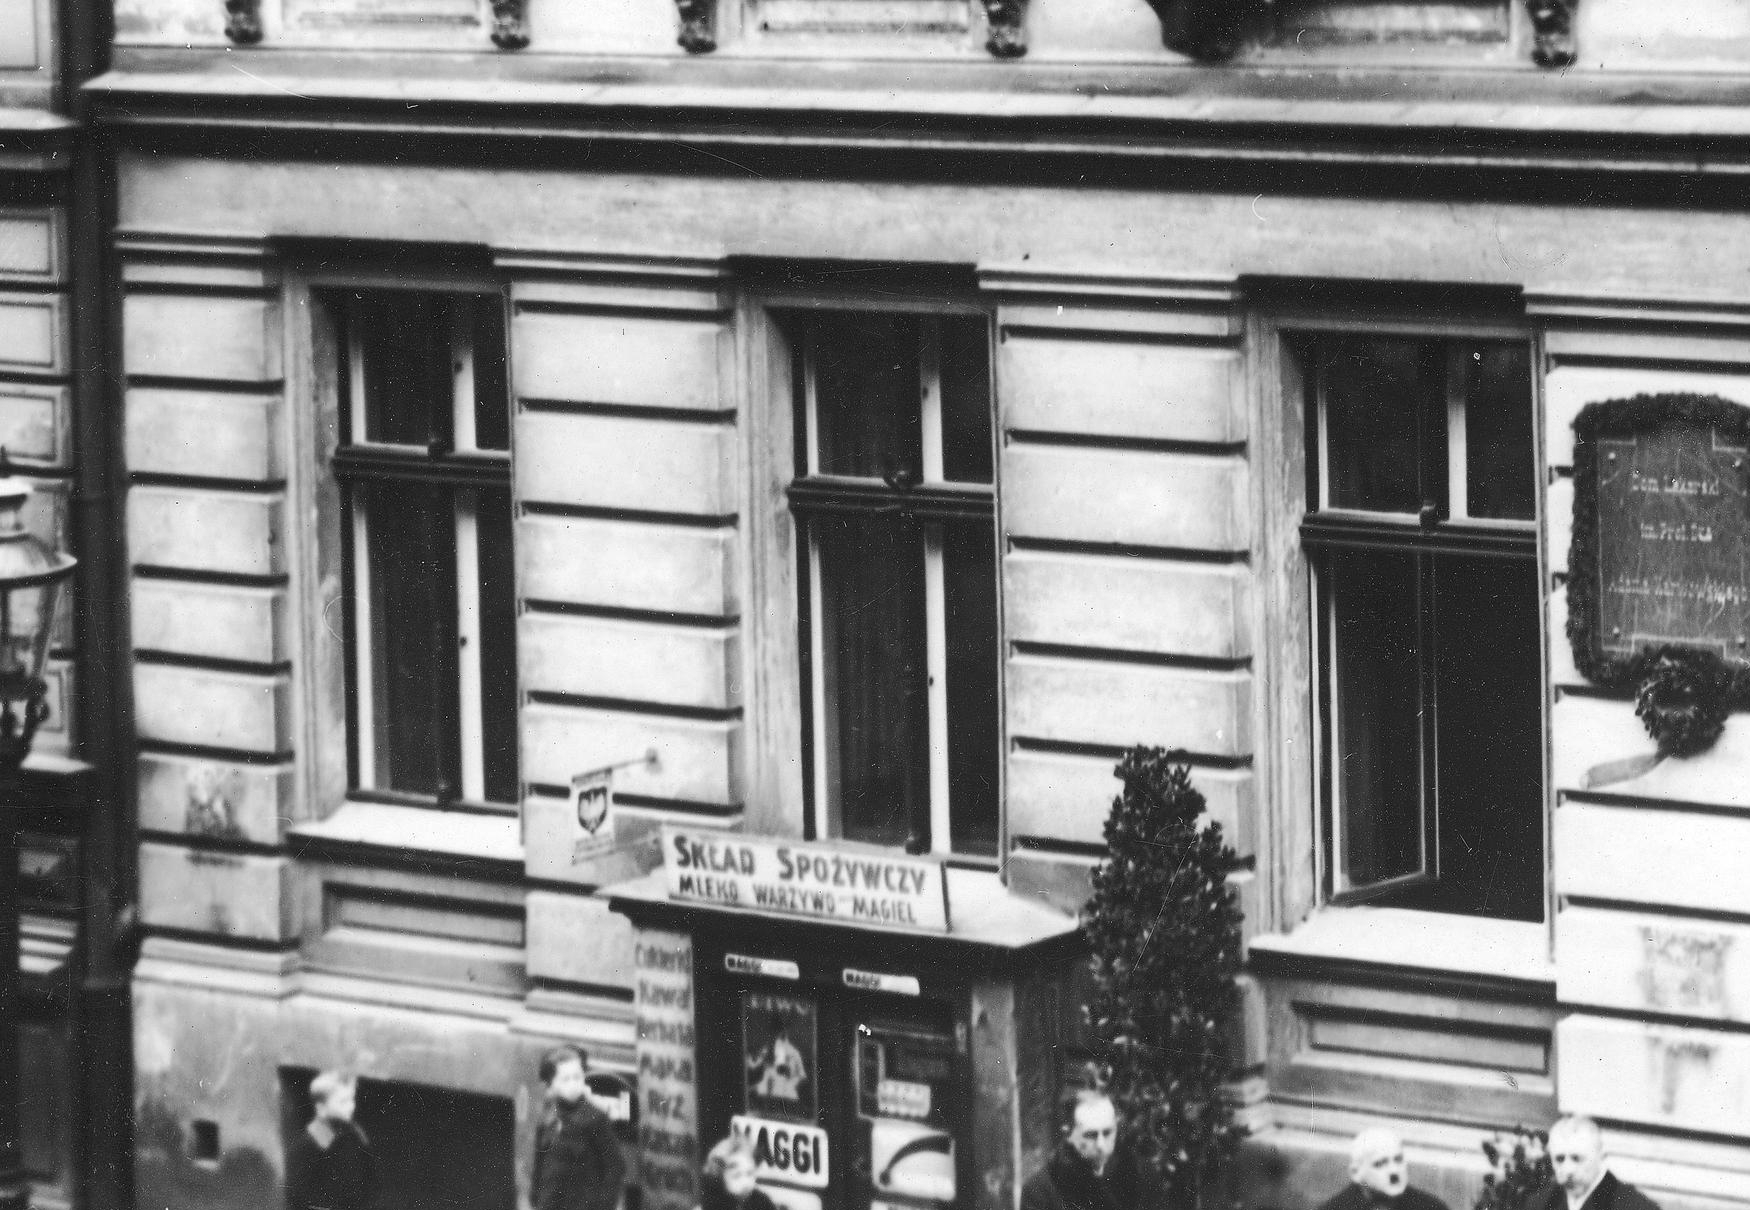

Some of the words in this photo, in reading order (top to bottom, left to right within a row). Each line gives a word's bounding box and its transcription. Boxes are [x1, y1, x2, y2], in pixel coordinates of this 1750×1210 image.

[674, 835, 754, 876] SKŁAD
[777, 846, 925, 895] SPOŻYWCZY
[679, 874, 738, 901] MLEKO
[853, 894, 917, 924] MAGIEL
